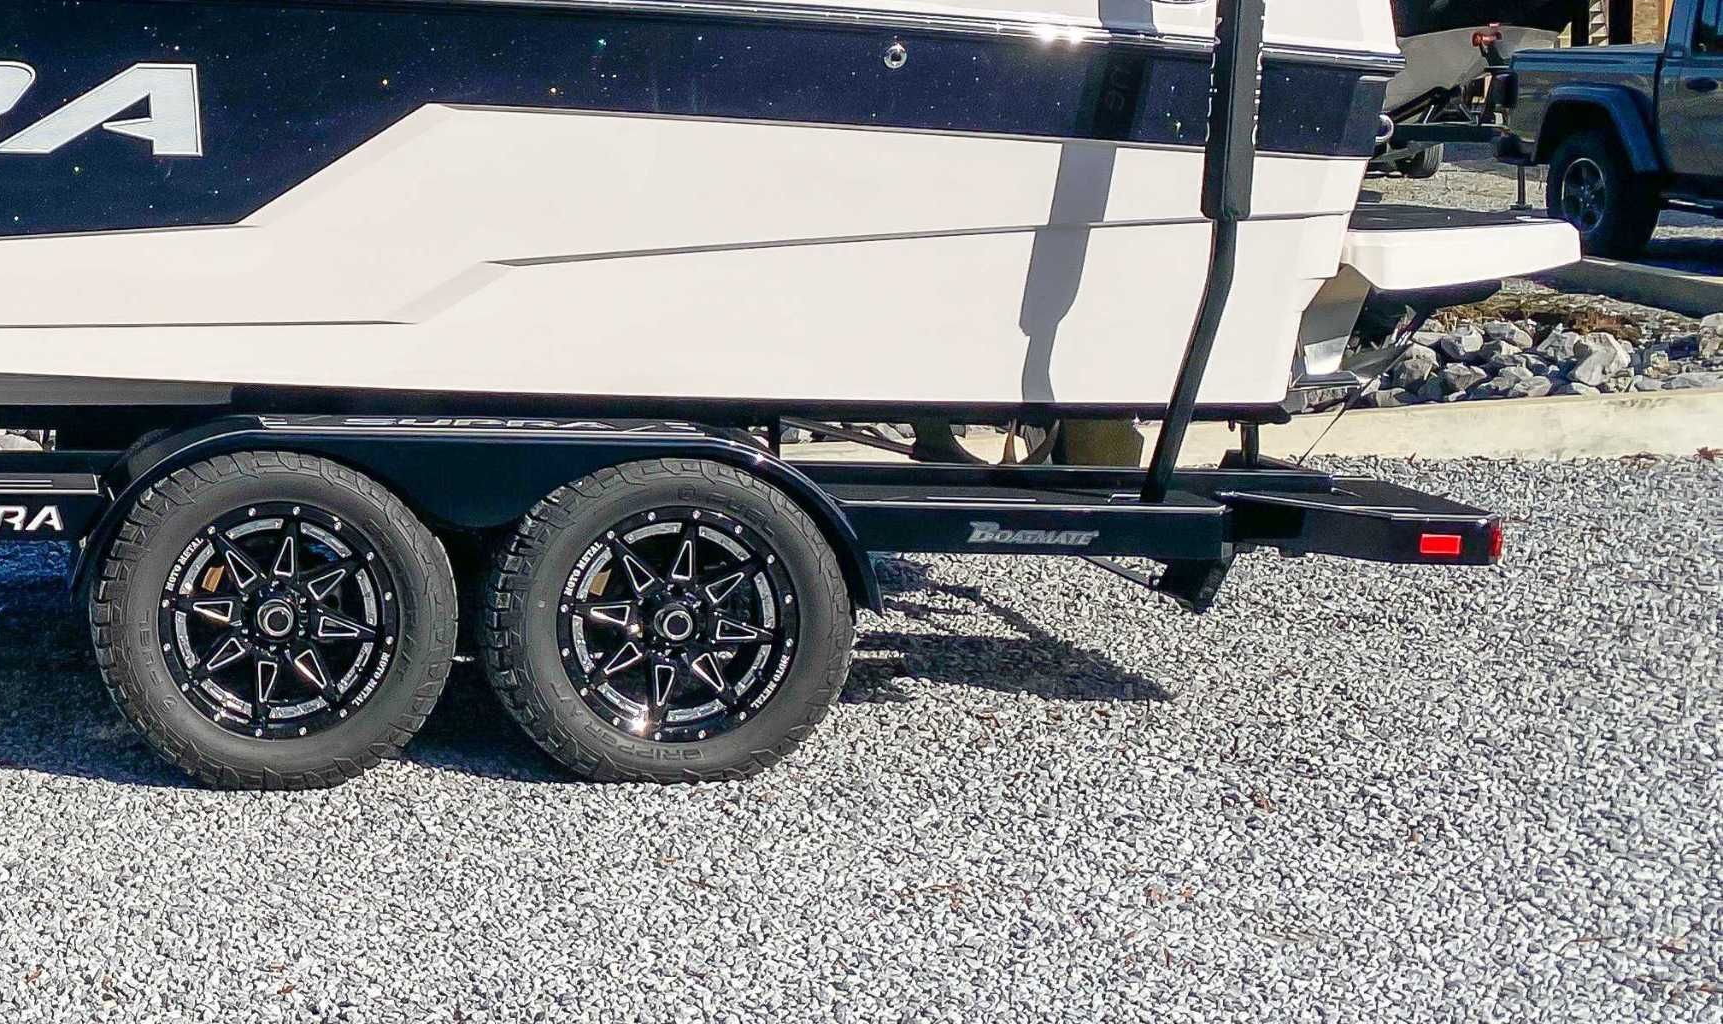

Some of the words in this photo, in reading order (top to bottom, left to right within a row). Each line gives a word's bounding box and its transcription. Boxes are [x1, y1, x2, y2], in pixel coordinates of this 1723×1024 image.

[342, 418, 615, 431] SUPRA
[165, 564, 182, 592] MOTO
[177, 537, 204, 565] METAL
[564, 569, 581, 597] MOTO
[576, 541, 603, 570] METAL
[373, 652, 391, 679] MOTO
[772, 654, 791, 682] MOTO
[351, 678, 378, 707] METAL
[750, 680, 778, 709] METAL
